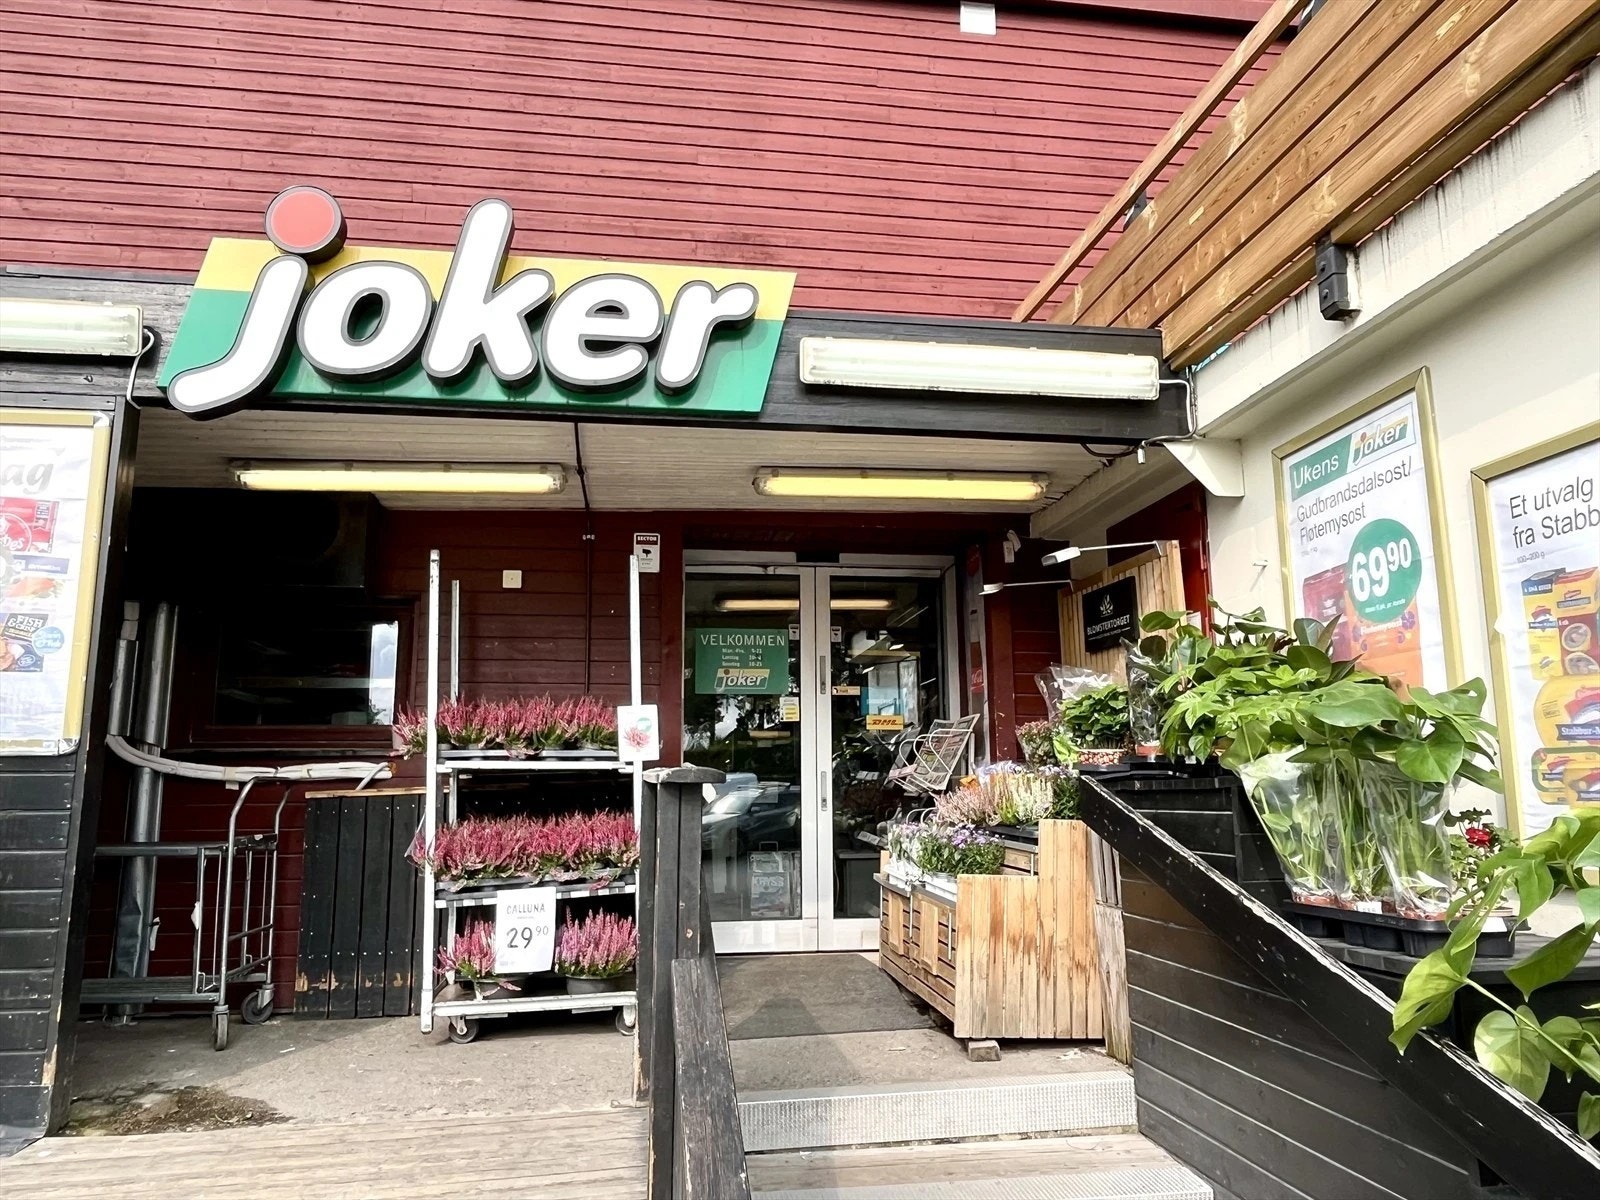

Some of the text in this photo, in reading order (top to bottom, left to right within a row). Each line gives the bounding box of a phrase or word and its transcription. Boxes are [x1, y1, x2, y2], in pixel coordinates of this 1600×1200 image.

[167, 185, 760, 420] joker
[1294, 422, 1406, 489] Ukens joker
[1509, 476, 1594, 519] Et utvalg
[1299, 502, 1367, 545] Fløtemysost
[1512, 504, 1600, 549] fra Stabb
[17, 615, 44, 628] FISH
[701, 634, 785, 646] VELKOMMEN
[716, 669, 765, 694] joker
[506, 903, 546, 914] CALLUNA
